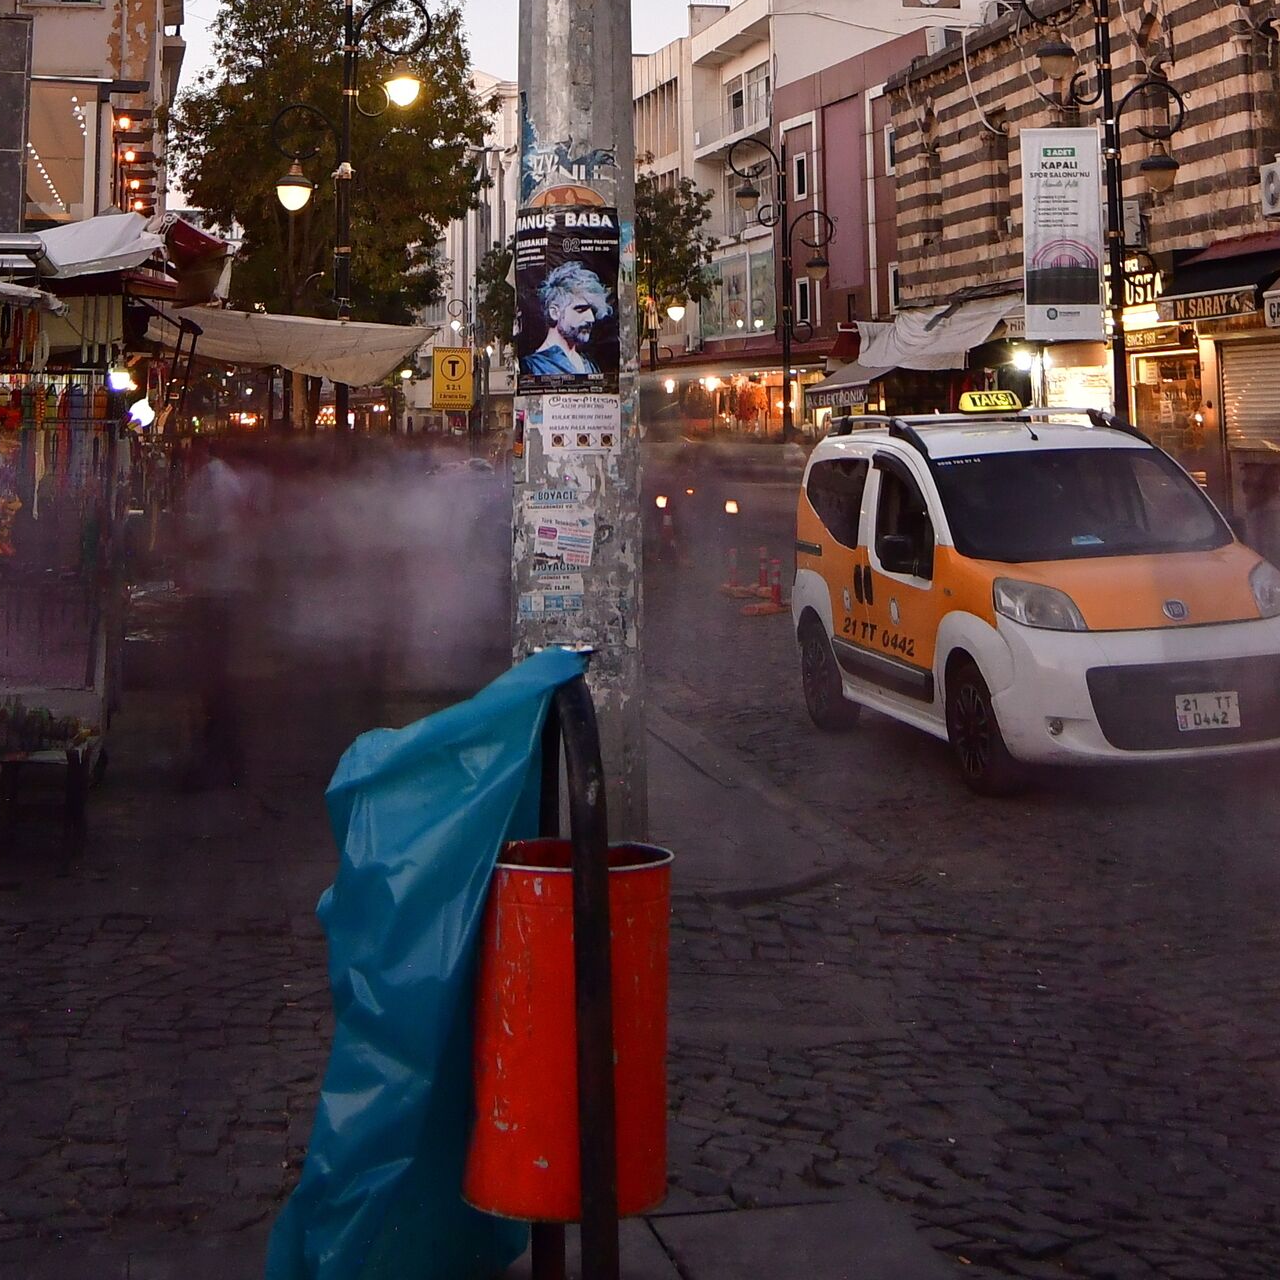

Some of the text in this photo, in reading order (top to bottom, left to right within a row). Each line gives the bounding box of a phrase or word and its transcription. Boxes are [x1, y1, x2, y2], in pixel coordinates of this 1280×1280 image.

[1041, 161, 1078, 170] KAPALI
[1029, 171, 1048, 179] SPOR
[564, 212, 614, 228] BABA
[562, 237, 580, 252] 02
[1124, 272, 1163, 305] USTA
[1176, 294, 1229, 319] N.SARAY
[1126, 334, 1143, 347] SINCE
[448, 360, 459, 377] T
[843, 617, 915, 657] 21 TT 0442
[1183, 696, 1231, 711] 21 TT
[1193, 712, 1229, 726] 0442
